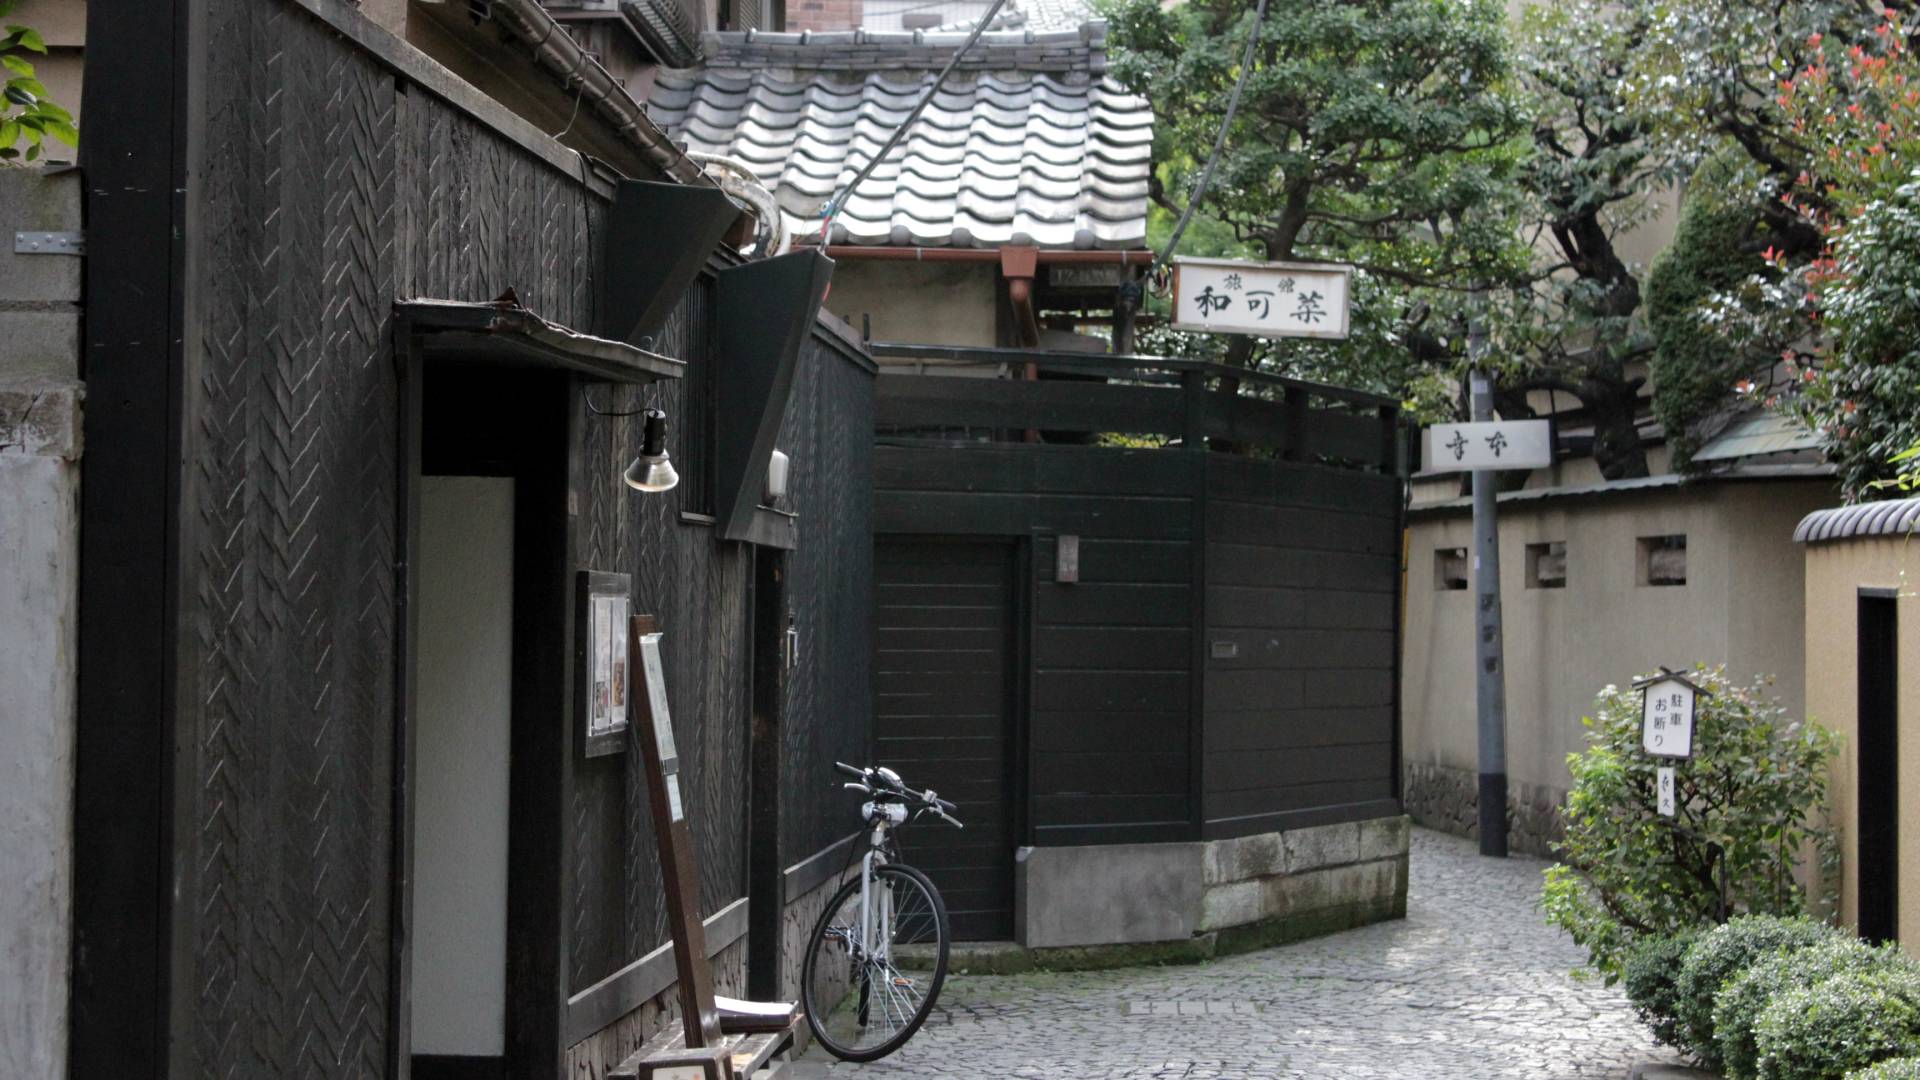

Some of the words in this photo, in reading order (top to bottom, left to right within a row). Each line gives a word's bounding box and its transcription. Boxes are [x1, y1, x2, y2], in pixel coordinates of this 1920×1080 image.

[1194, 285, 1327, 324] 和可菜
[1654, 698, 1667, 747] お断り
[1670, 694, 1683, 726] 駐車
